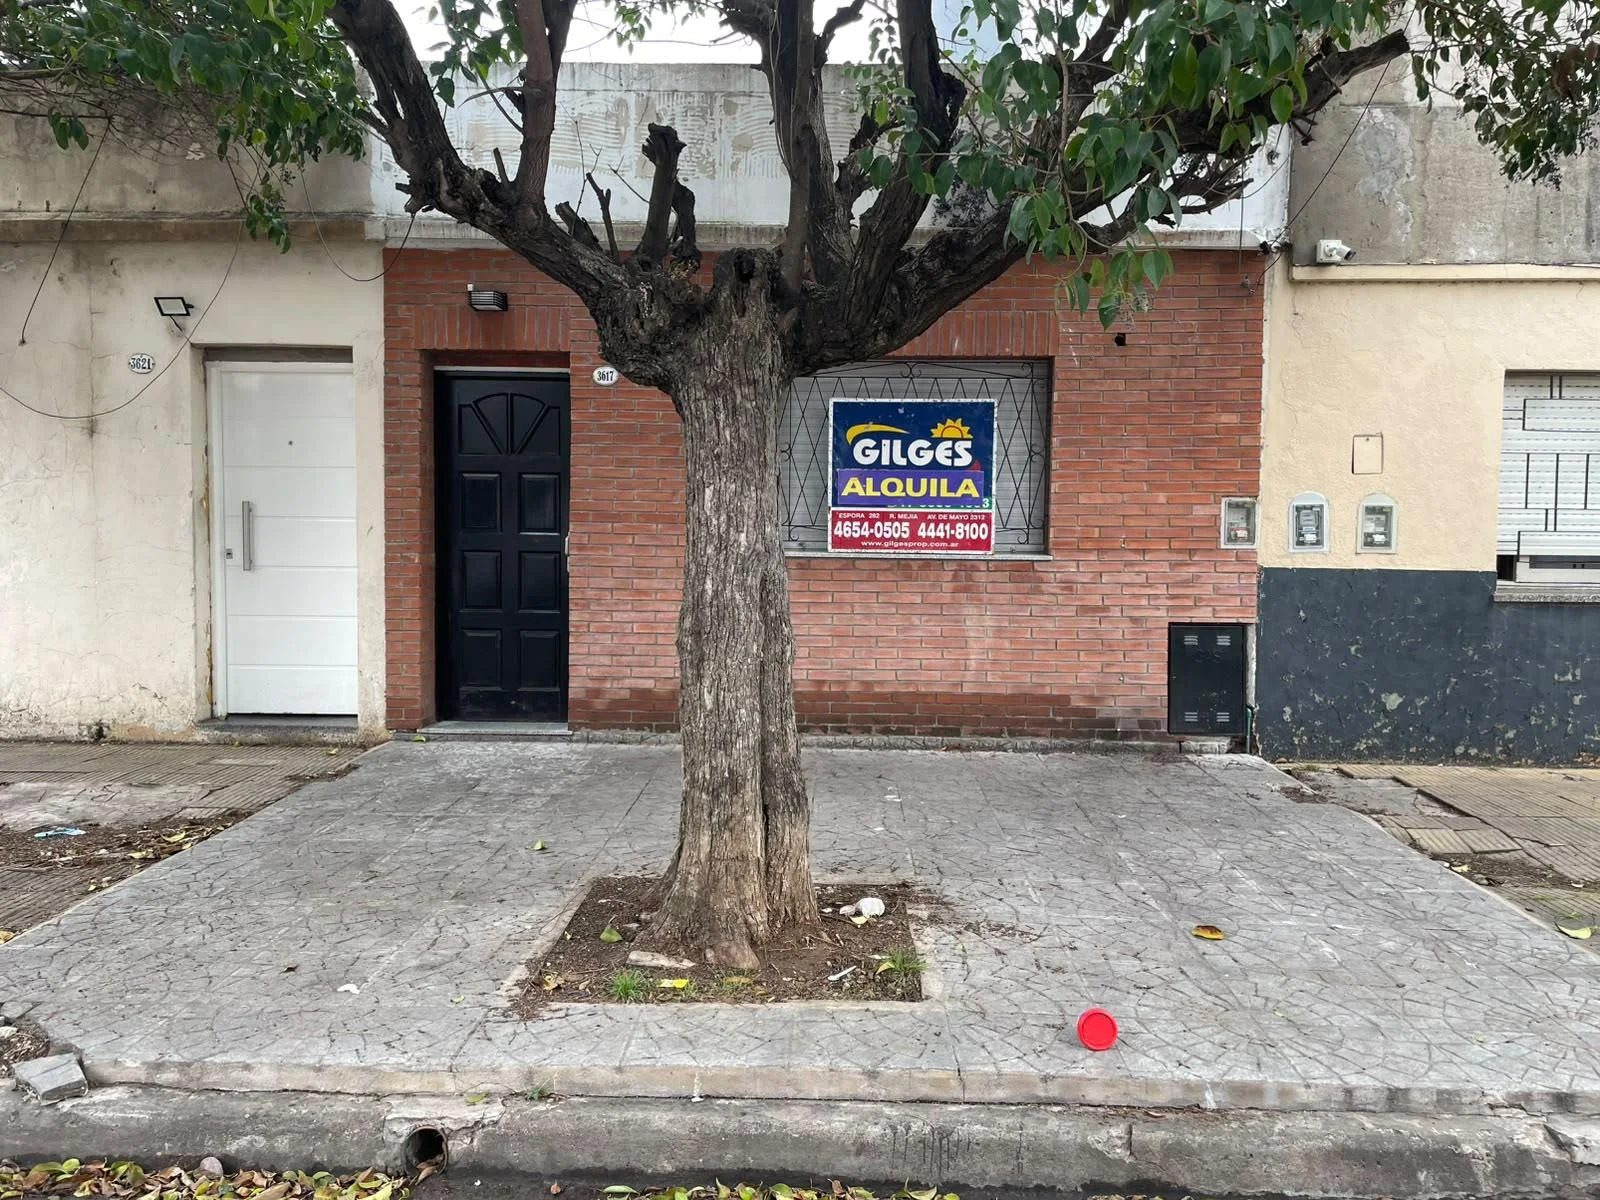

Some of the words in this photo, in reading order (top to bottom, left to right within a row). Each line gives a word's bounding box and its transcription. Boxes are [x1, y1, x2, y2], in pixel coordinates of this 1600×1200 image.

[130, 358, 151, 370] 3621
[597, 371, 614, 381] 3617
[853, 438, 972, 466] GILGES
[842, 477, 980, 498] ALQUILA
[834, 520, 910, 538] 4654-0505
[918, 522, 988, 540] 4441-8100
[861, 540, 959, 548] www.gilgesprop.com.ar
